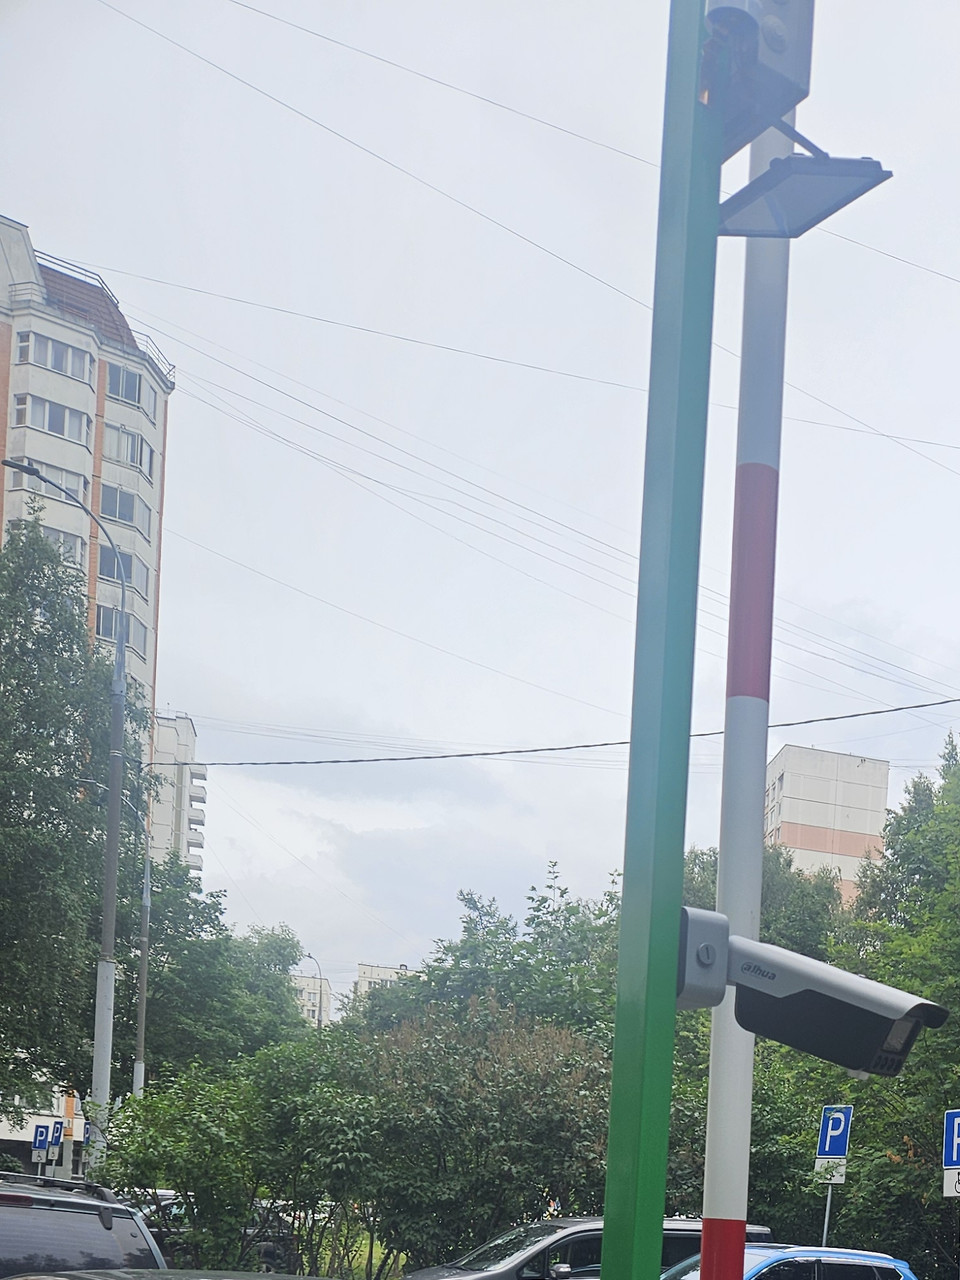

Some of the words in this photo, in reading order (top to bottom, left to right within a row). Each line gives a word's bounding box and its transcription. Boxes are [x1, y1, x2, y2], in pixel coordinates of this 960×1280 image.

[36, 1127, 46, 1147] P
[52, 1124, 61, 1144] P
[825, 1112, 846, 1152] P
